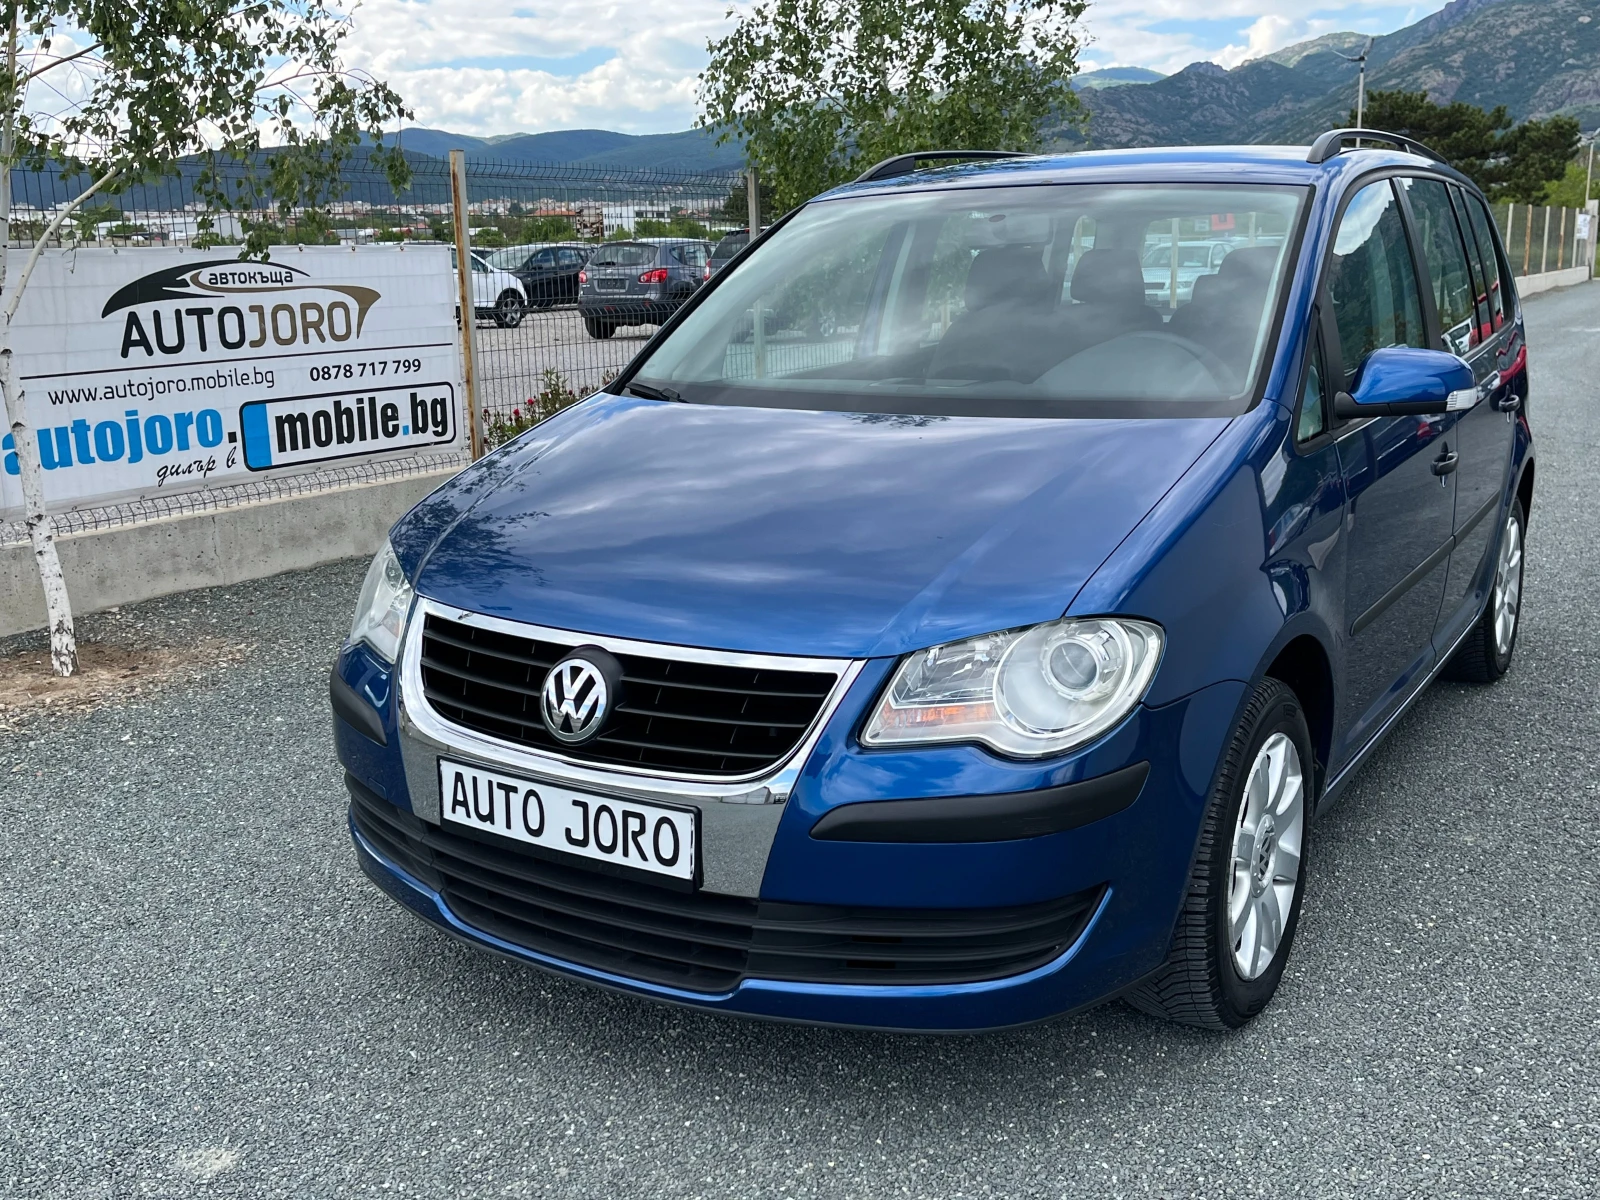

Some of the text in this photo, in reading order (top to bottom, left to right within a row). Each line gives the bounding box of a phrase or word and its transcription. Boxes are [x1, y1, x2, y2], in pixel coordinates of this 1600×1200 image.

[208, 270, 294, 287] автокъща
[120, 301, 352, 359] AUTOJORO
[48, 366, 275, 405] www.autojoro.mobile.bg
[309, 358, 422, 382] 0878 717 799
[274, 392, 449, 454] mobile.bg
[451, 771, 680, 868] AUTO JORO
